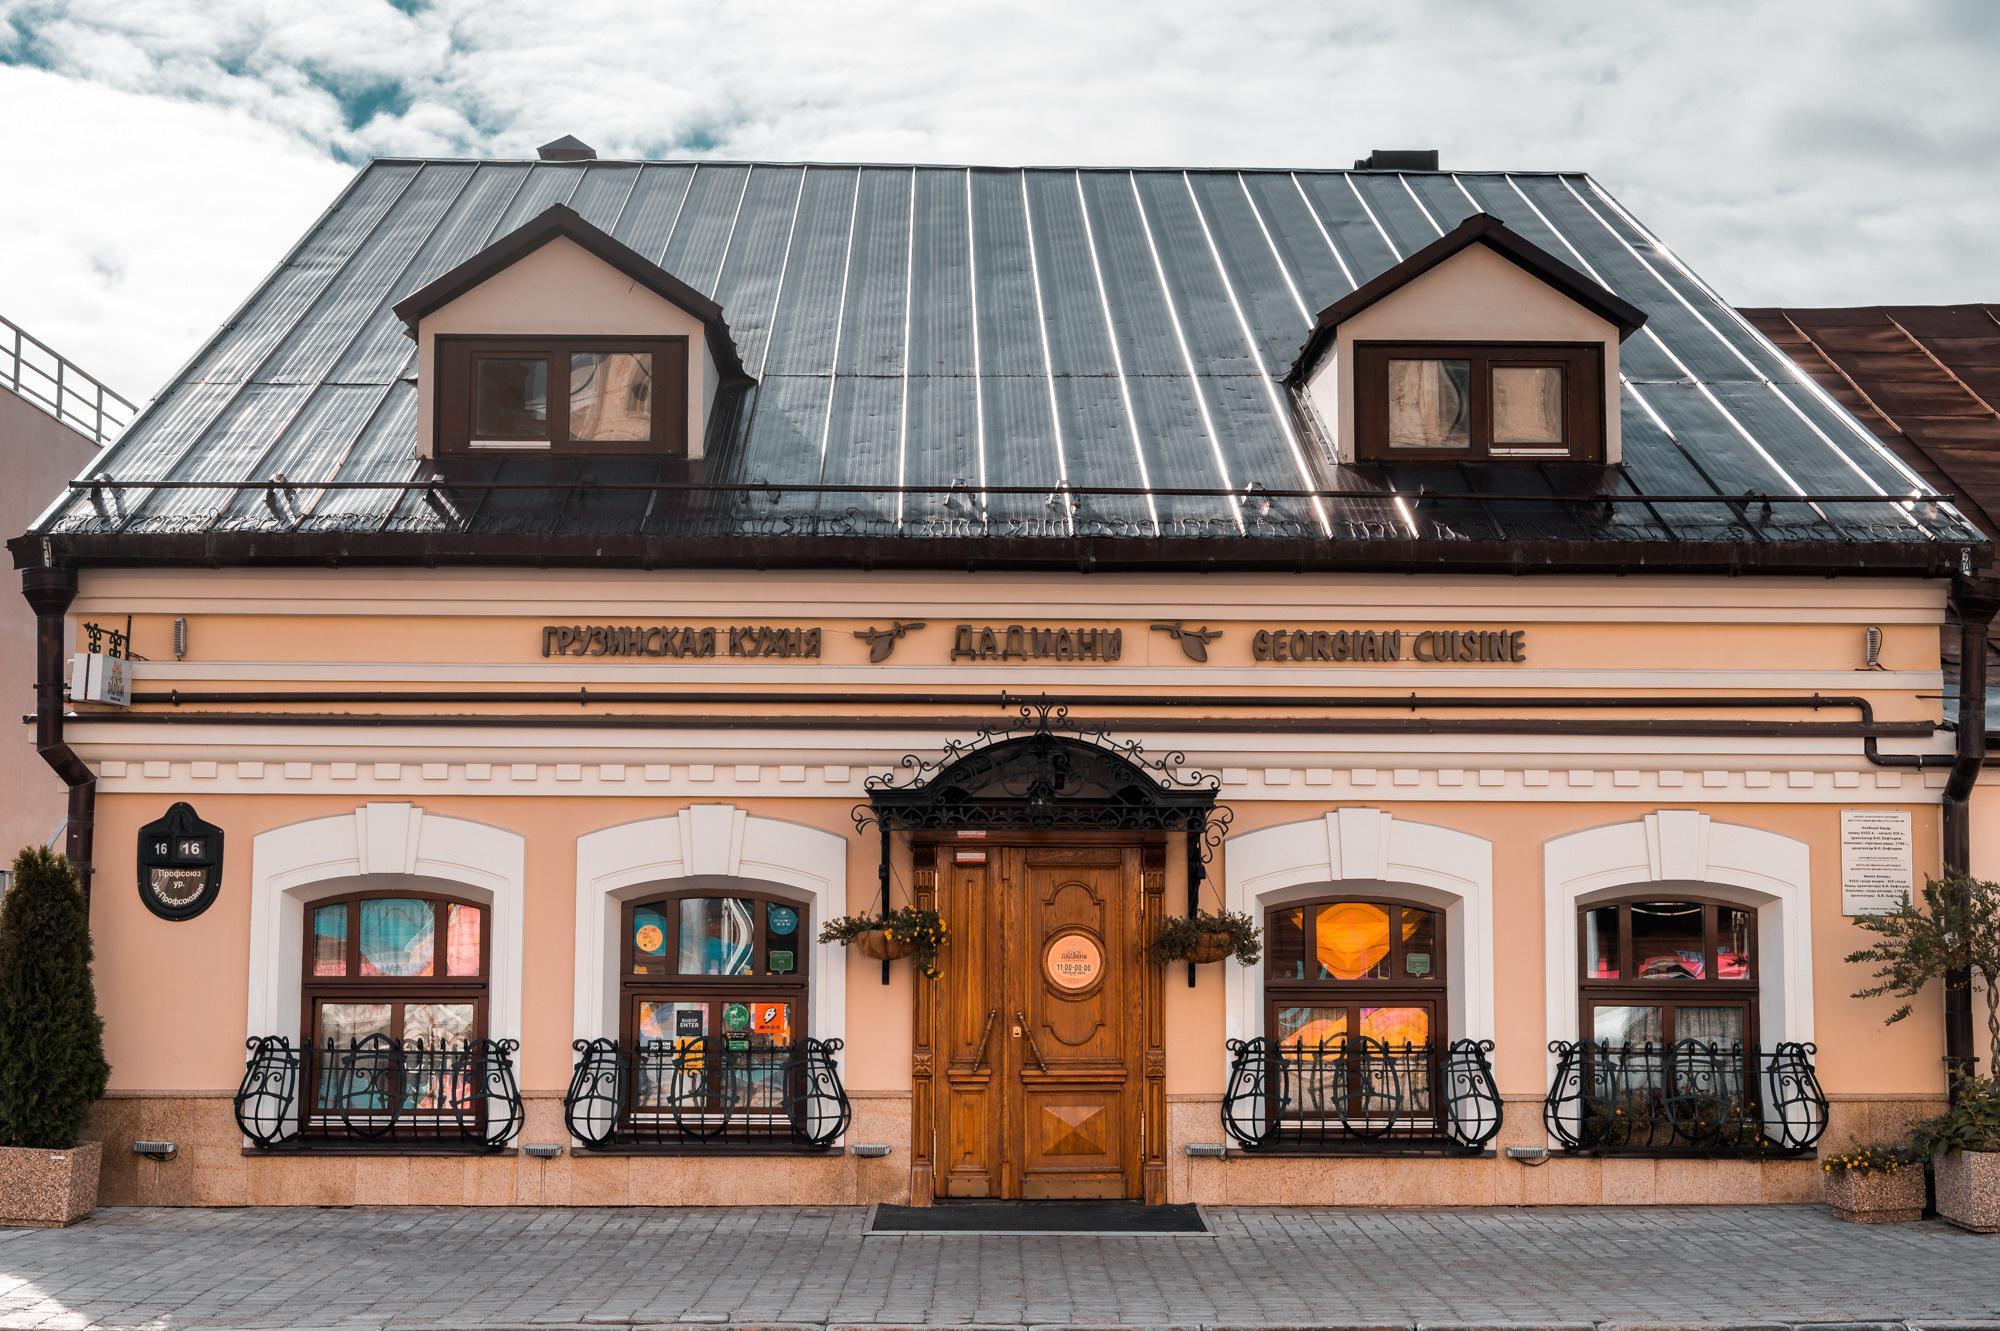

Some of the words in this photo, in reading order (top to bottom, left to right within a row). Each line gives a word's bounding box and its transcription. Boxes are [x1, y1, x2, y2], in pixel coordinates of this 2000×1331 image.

[542, 625, 716, 658] ГРУЗИНСКАЯ
[729, 625, 822, 658] КУХНЯ
[951, 625, 1122, 661] ДАДИАНИ
[1252, 629, 1401, 662] GEORGIAN
[1413, 629, 1526, 662] CUISINE
[154, 842, 167, 855] 16
[182, 842, 200, 855] 16
[158, 870, 202, 879] Профсоюз
[173, 881, 186, 889] ур.
[151, 881, 160, 895] ул.
[158, 883, 204, 906] Профсоюзная
